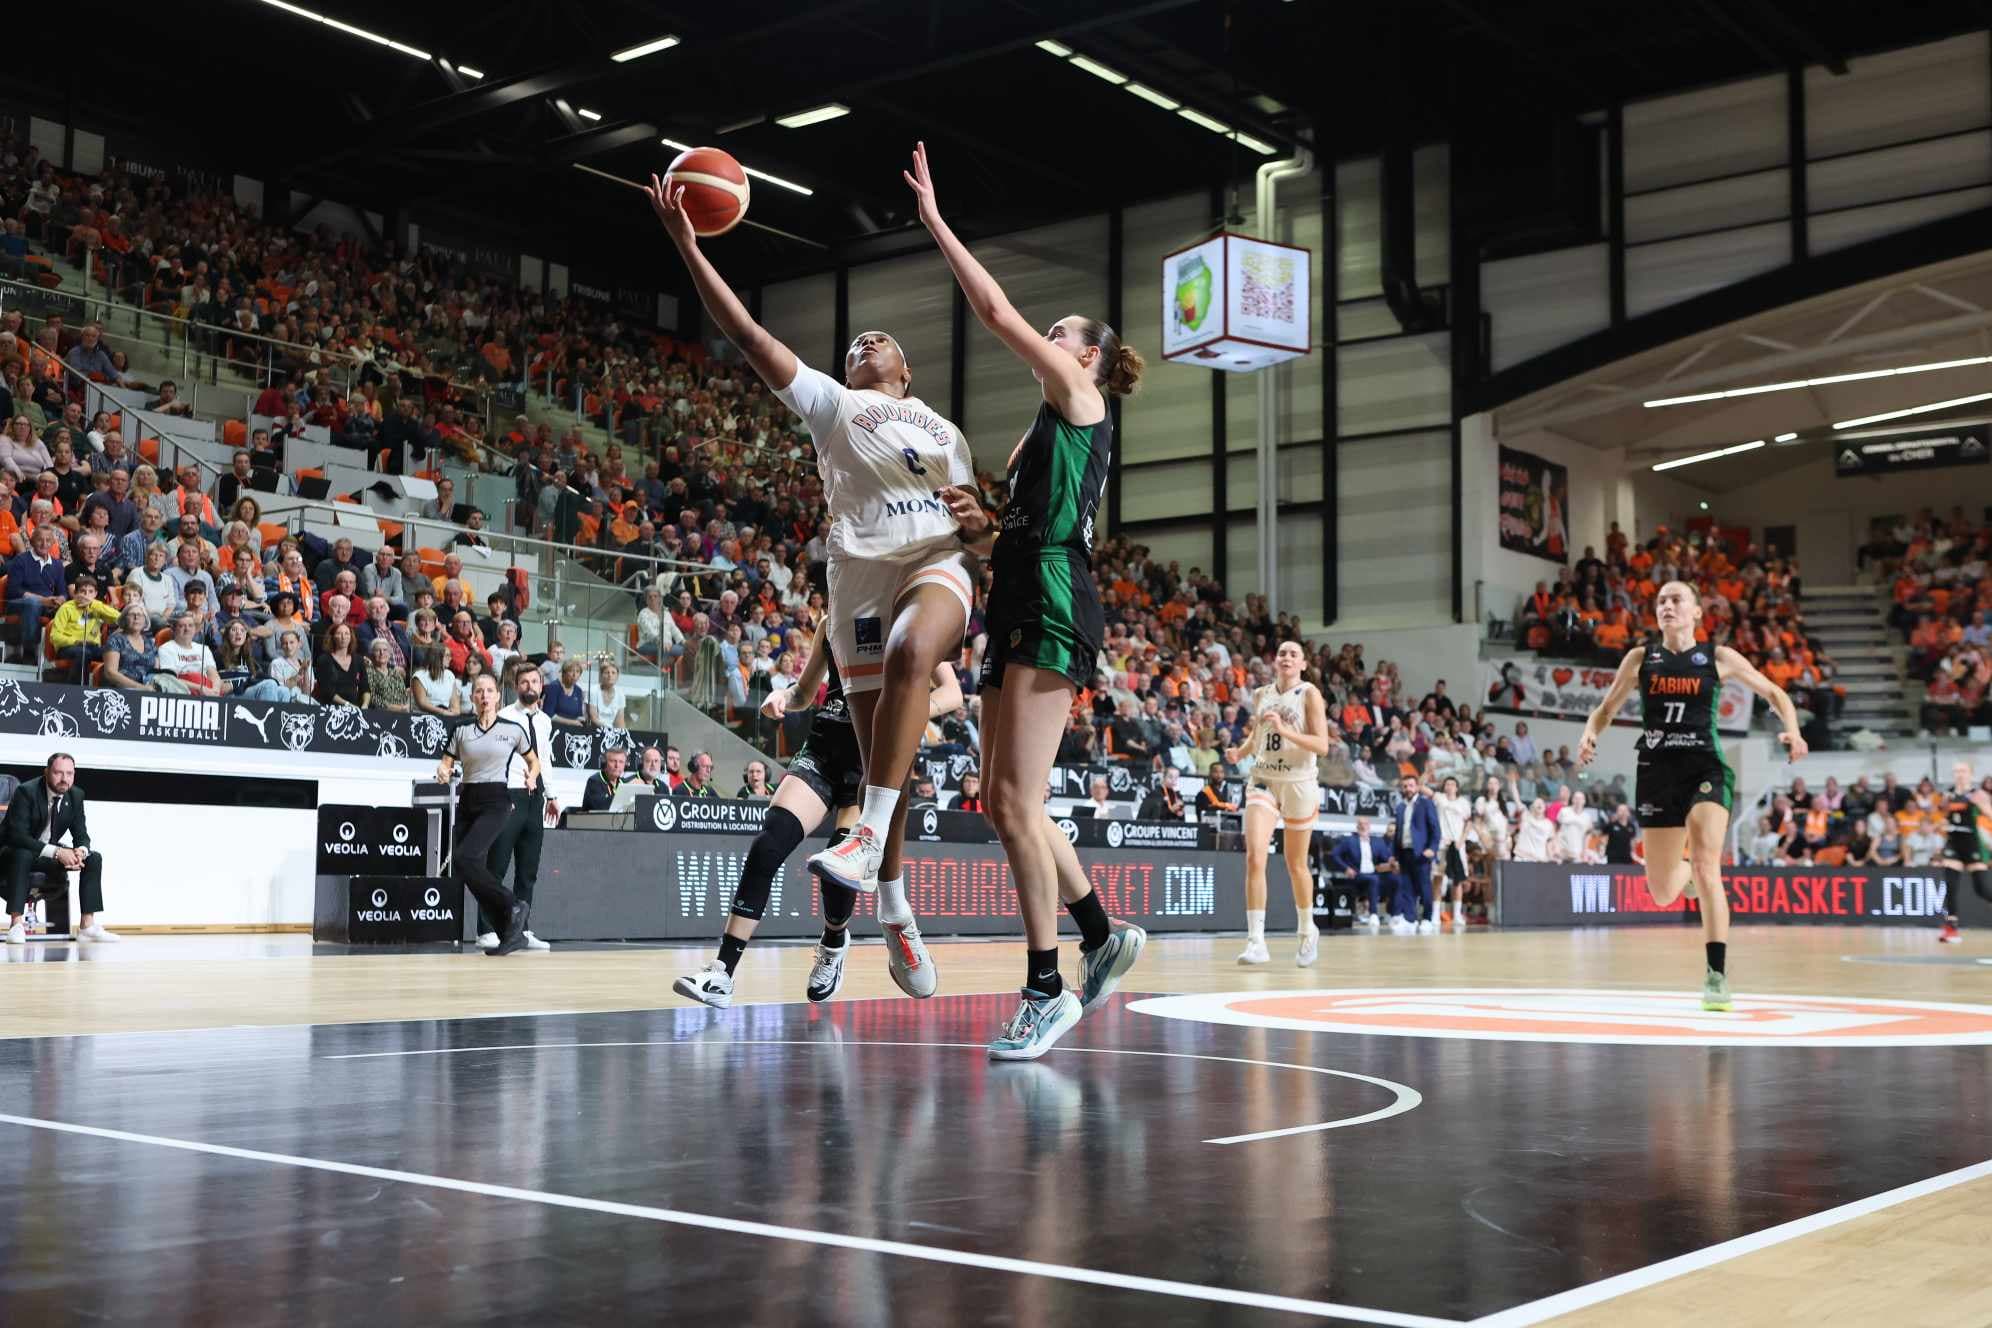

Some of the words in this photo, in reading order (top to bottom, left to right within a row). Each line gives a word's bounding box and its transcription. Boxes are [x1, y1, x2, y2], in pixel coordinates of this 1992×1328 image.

[852, 404, 952, 446] BOURGES
[1649, 672, 1701, 695] ŽABINY
[140, 696, 220, 730] PUMA
[1664, 702, 1686, 723] 77
[140, 726, 218, 740] BASKETBALL
[1265, 733, 1281, 751] 18
[680, 801, 736, 820] GROUPE
[681, 822, 722, 830] DISTRIBUTION
[729, 823, 758, 831] LOCATION
[1124, 823, 1160, 839] GROUPE
[1161, 827, 1198, 839] VINCENT
[325, 842, 368, 855] VEOLIA
[379, 844, 422, 856] VEOLIA
[357, 910, 401, 921] VEOLIA
[410, 909, 453, 920] VEOLIA
